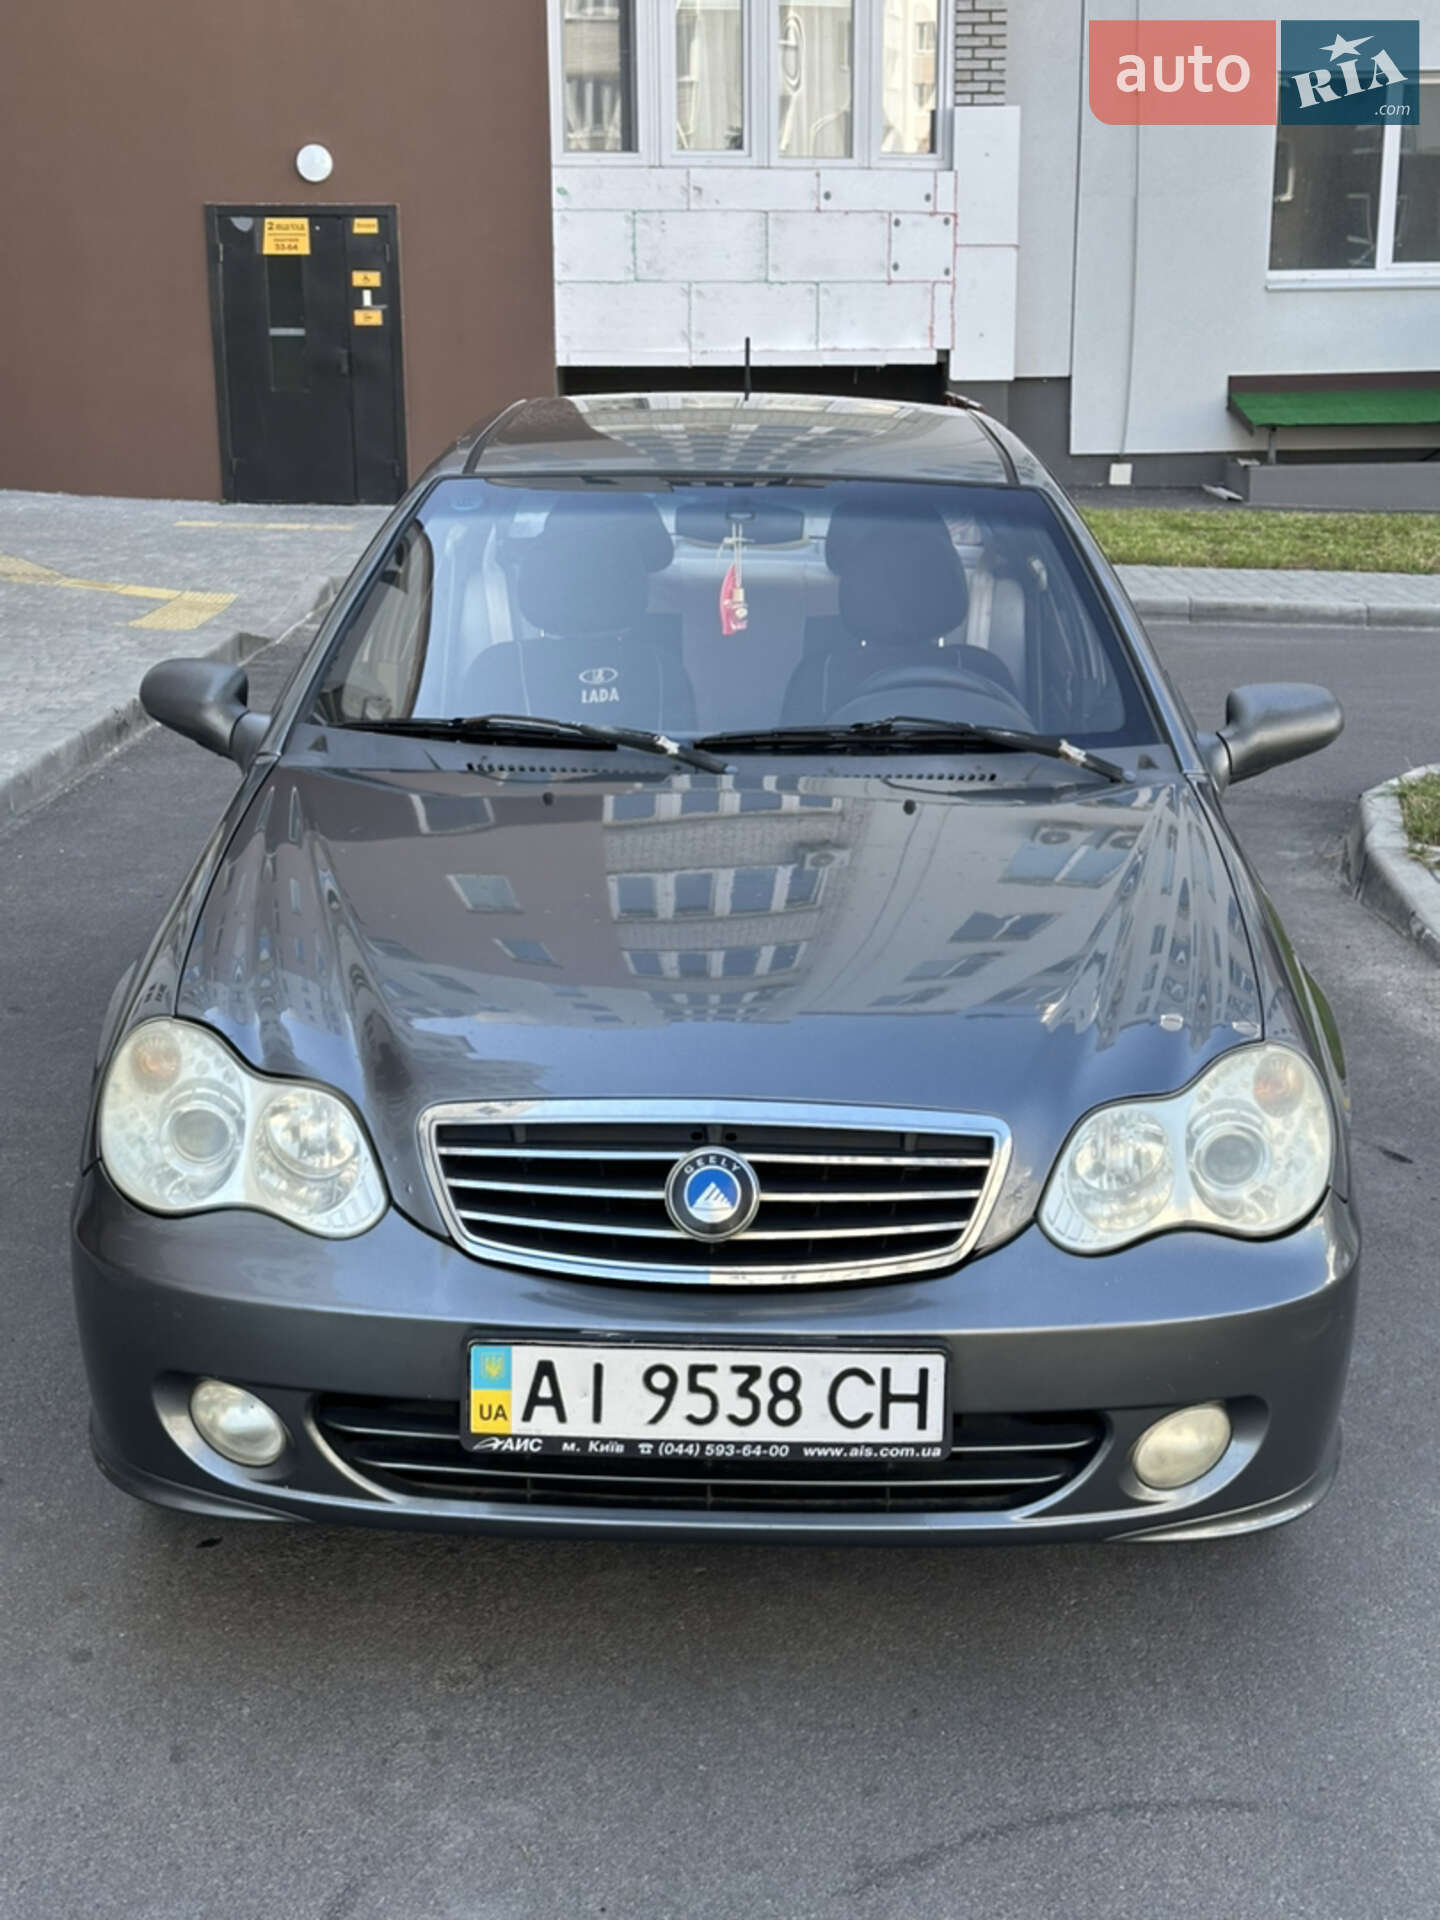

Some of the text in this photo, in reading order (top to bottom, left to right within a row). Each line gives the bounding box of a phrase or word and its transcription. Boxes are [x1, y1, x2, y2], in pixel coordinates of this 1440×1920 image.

[581, 687, 621, 704] LADA
[683, 1154, 741, 1175] GEELY
[642, 1363, 802, 1428] 9538
[827, 1366, 929, 1431] CH
[479, 1405, 508, 1421] UA
[562, 1442, 581, 1452] м.
[588, 1440, 625, 1453] Київ
[658, 1442, 700, 1457] (044)
[705, 1443, 790, 1457] 593-64-00
[803, 1444, 942, 1458] www.ais.com.ua
